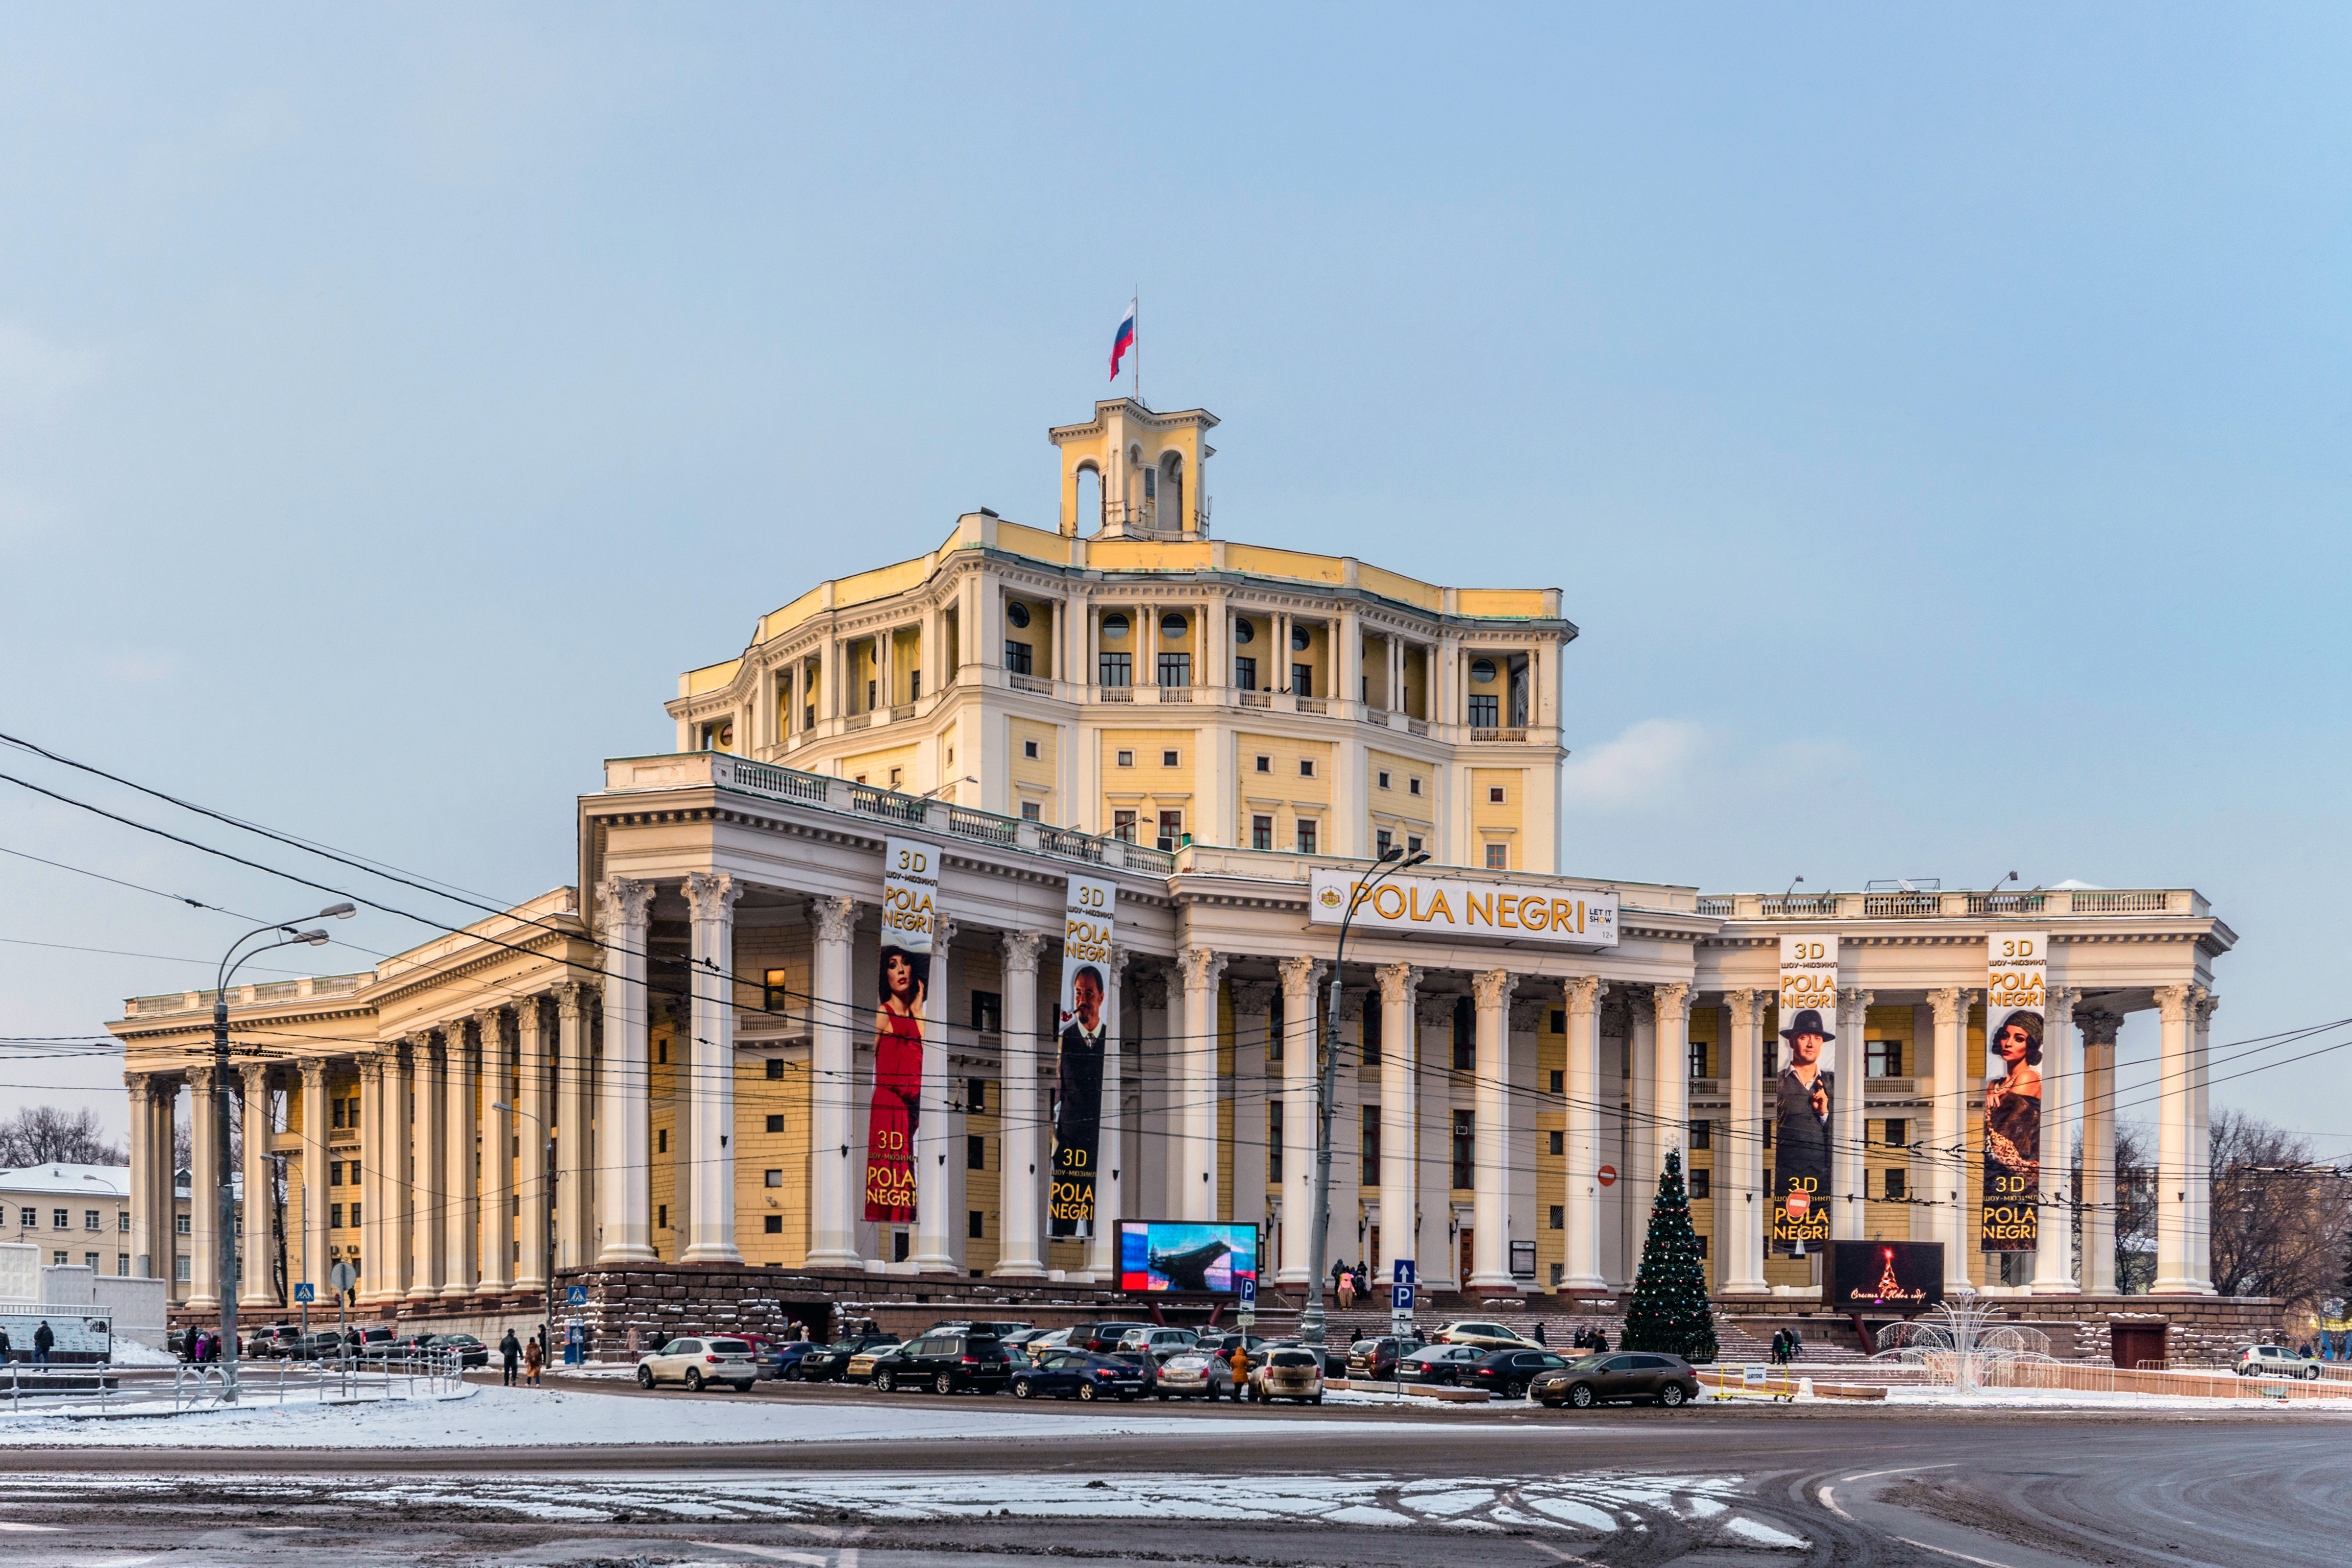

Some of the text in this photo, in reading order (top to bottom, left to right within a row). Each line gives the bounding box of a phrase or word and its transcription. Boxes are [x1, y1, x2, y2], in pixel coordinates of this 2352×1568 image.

[898, 849, 926, 872] 3D
[886, 870, 937, 887] ШОУ-МЮЗИКЛ
[884, 885, 934, 914] POLA
[1079, 885, 1103, 906] 3D
[1067, 905, 1114, 920] ШОУ-МЮЗИКЛ
[1350, 882, 1585, 934] POLA NEGRI
[883, 908, 933, 933] NEGRI
[1067, 919, 1111, 946] POLA
[1065, 940, 1110, 964] NEGRI
[1794, 943, 1824, 959] 3D
[2003, 940, 2033, 956] 3D
[1782, 975, 1837, 992] POLA
[1989, 972, 2045, 990] POLA
[1781, 993, 1836, 1008] NEGRI
[1988, 991, 2044, 1006] NEGRI
[878, 1130, 903, 1150] 3D
[868, 1152, 918, 1163] ШОУ-МЮЗИКЛ
[1063, 1149, 1087, 1167] 3D
[868, 1166, 916, 1188] POLA
[1051, 1169, 1097, 1177] ШОУ-МЮЗИКЛ
[1051, 1182, 1094, 1202] POLA
[1788, 1177, 1817, 1192] 3D
[1995, 1176, 2025, 1192] 3D
[867, 1188, 915, 1206] NEGRI
[1049, 1203, 1093, 1220] NEGRI
[1984, 1207, 2037, 1224] POLA
[1774, 1225, 1828, 1240] NEGRI
[1983, 1225, 2036, 1239] NEGRI
